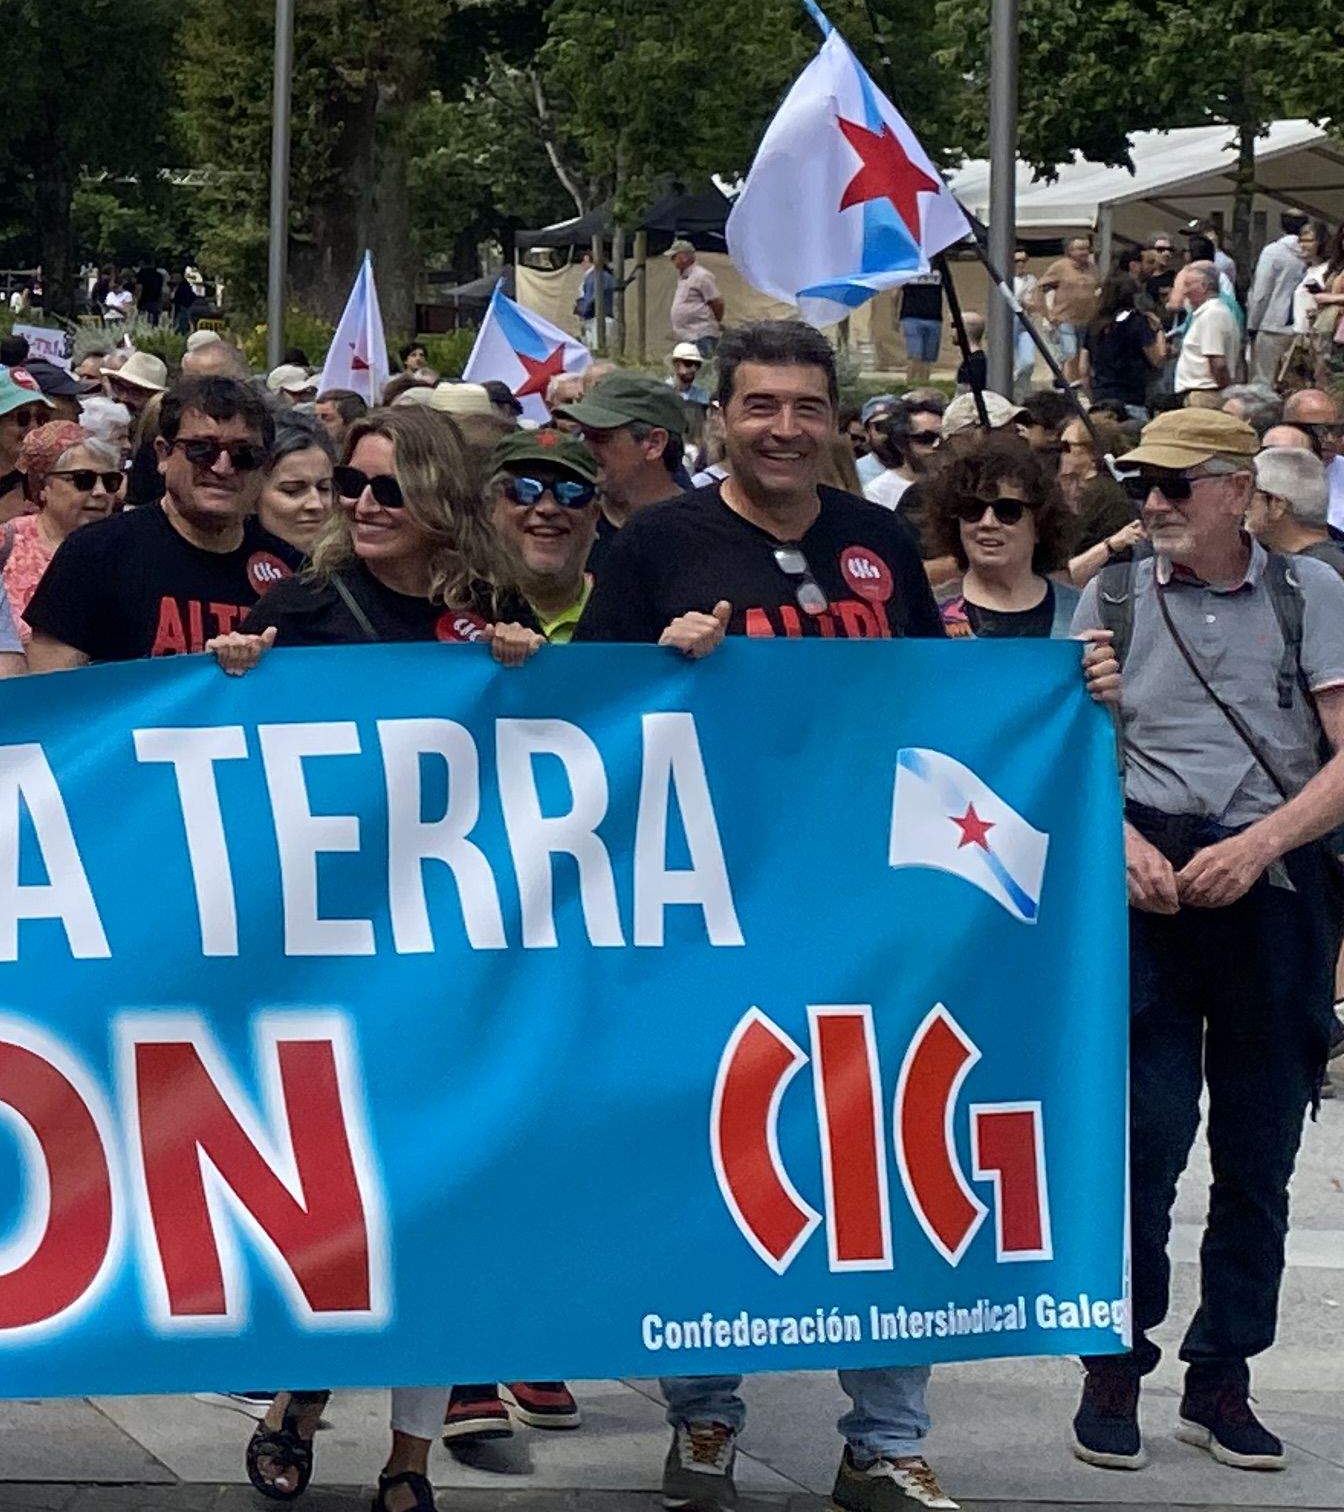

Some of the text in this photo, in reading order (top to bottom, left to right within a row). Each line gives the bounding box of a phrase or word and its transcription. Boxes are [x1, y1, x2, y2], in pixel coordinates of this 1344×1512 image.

[132, 712, 746, 957] TERRA
[711, 1002, 1054, 1275] CIG
[641, 1292, 1130, 1352] Confederación Intersindical Galeg
